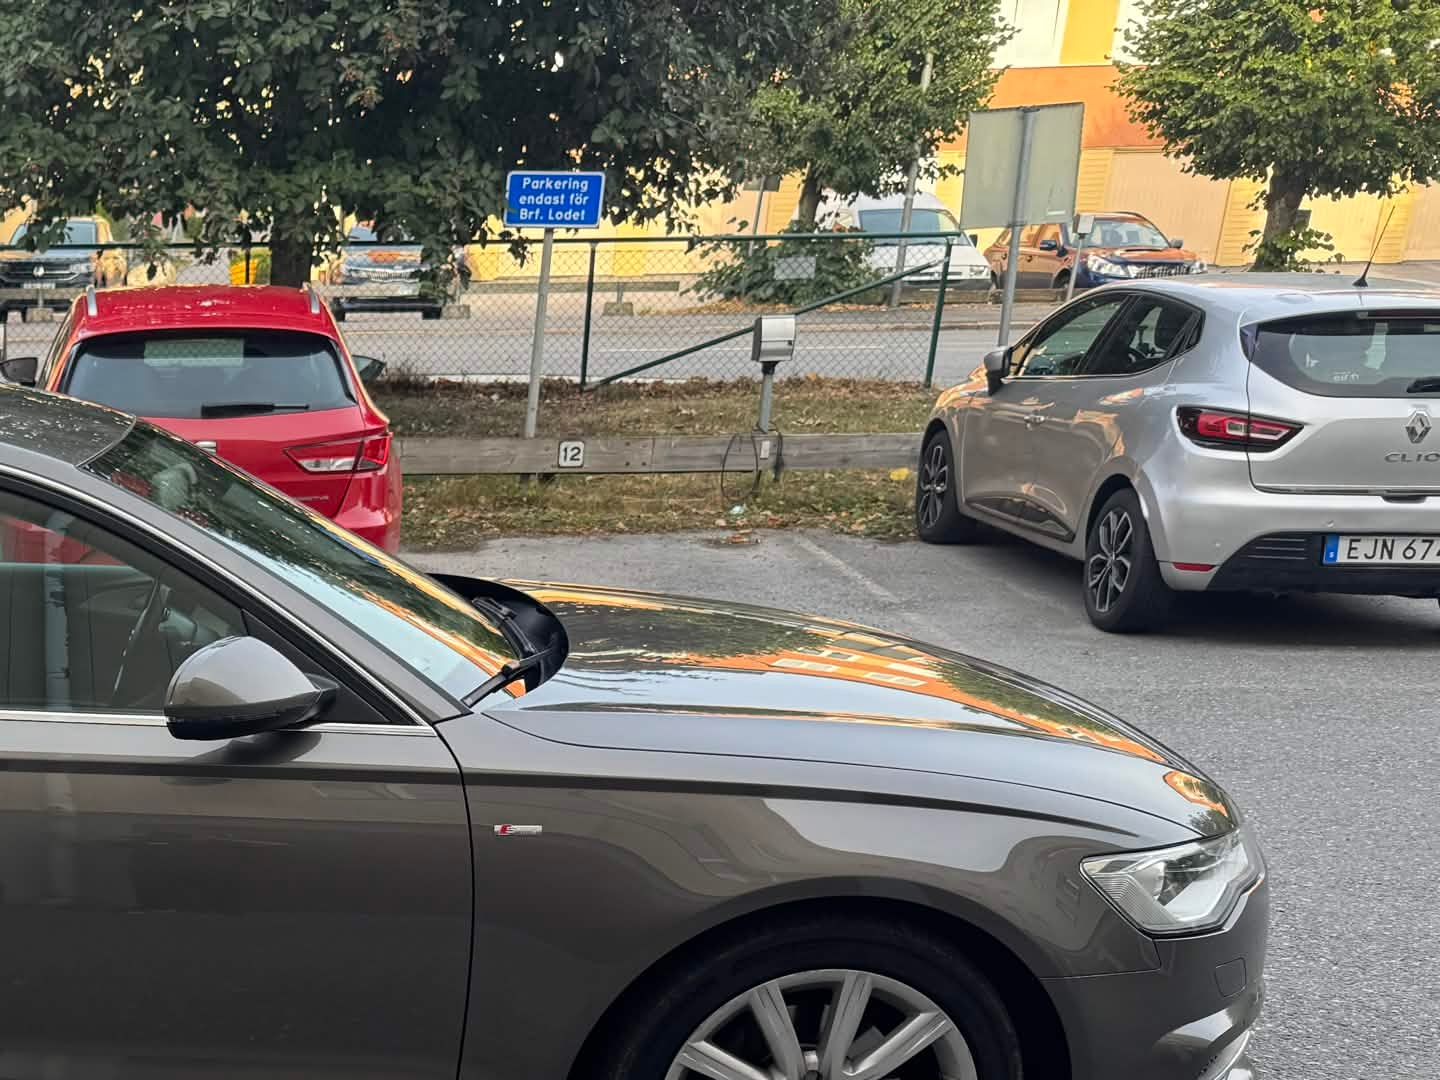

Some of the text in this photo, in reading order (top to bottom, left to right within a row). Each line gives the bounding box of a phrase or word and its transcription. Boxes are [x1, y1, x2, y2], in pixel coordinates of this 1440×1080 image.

[522, 177, 589, 192] Parkering
[519, 192, 589, 206] endast för
[519, 208, 585, 221] Brf. Lodet
[563, 446, 581, 462] 12
[1384, 452, 1440, 463] CLIO
[1347, 538, 1395, 560] EJN
